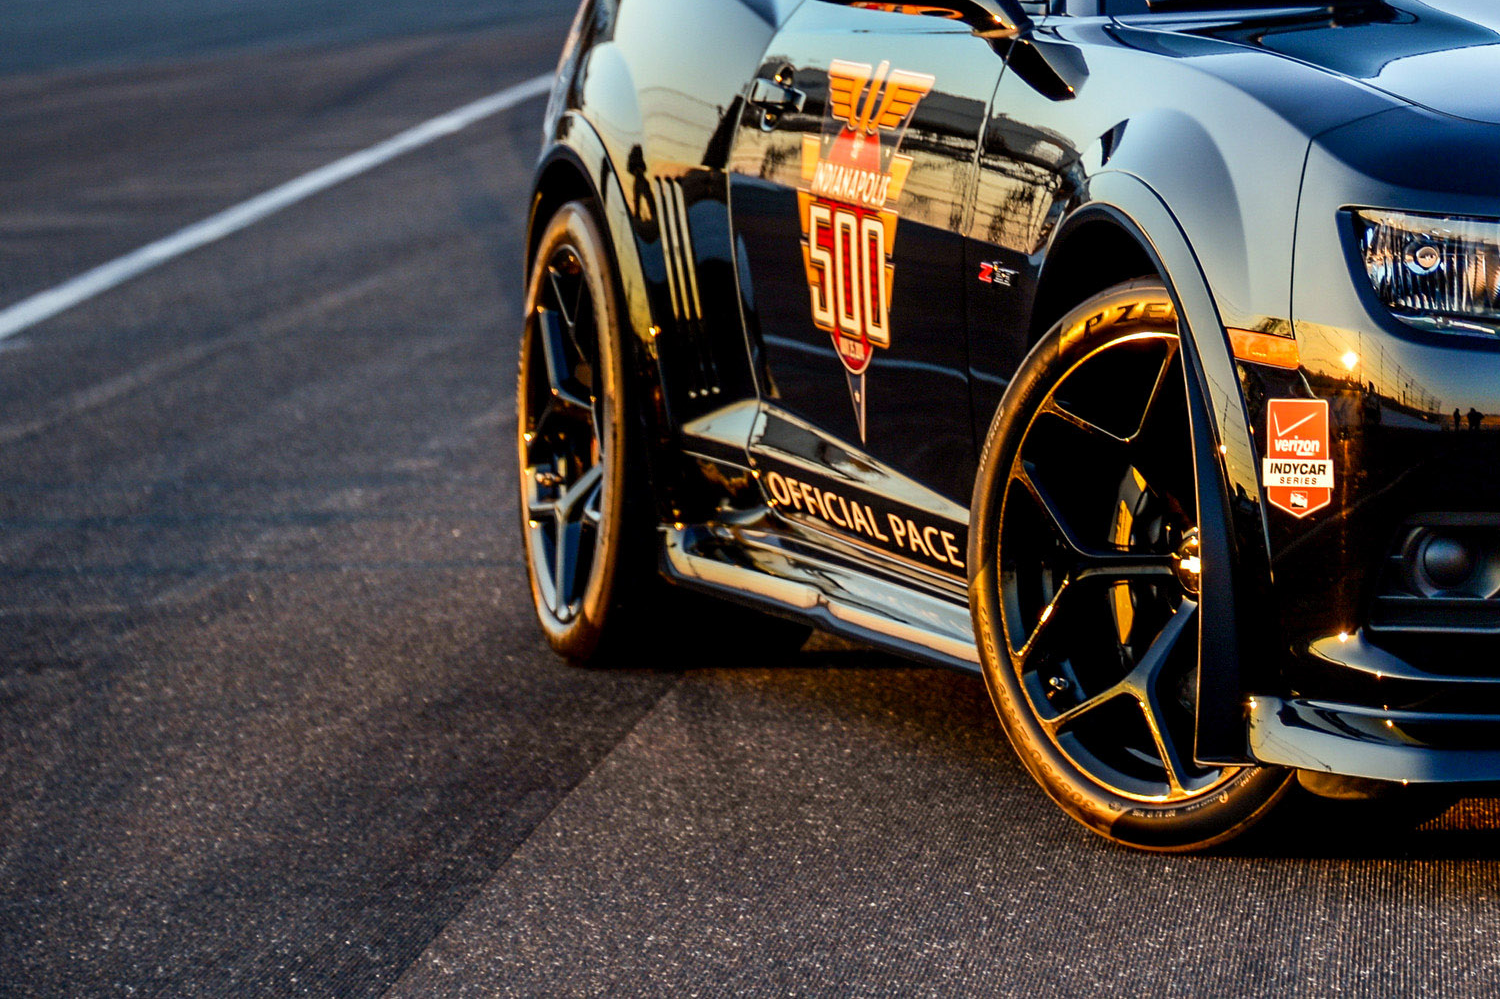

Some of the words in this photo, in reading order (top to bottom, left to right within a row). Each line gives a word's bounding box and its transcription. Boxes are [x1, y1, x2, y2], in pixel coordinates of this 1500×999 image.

[811, 161, 891, 207] INDIANAPOLIS
[808, 203, 890, 348] 500
[1274, 435, 1320, 456] verizon
[1270, 463, 1327, 475] INDYCAR
[1279, 477, 1317, 485] SERIES
[767, 471, 889, 543] OFFICIAL
[887, 513, 965, 568] PACE
